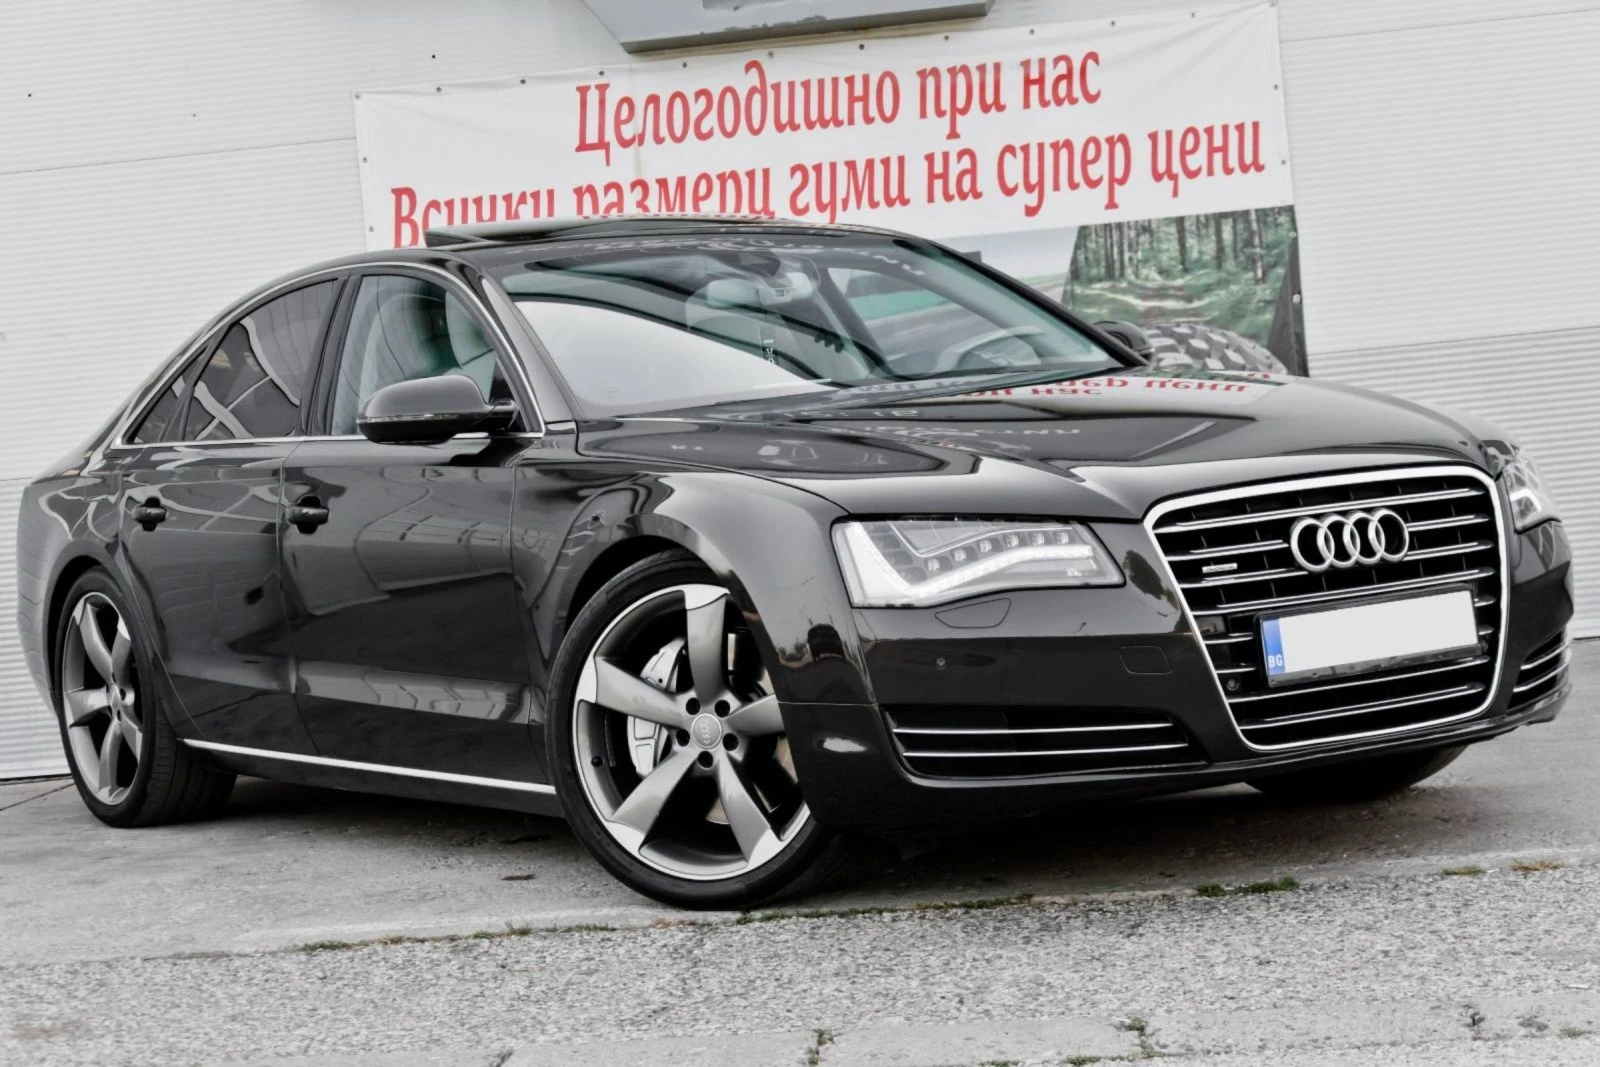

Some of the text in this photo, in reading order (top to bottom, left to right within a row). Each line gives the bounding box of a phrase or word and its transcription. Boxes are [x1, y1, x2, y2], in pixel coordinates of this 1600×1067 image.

[574, 50, 1102, 167] Целогодишно при нас
[787, 154, 912, 226] гуми
[923, 146, 984, 205] на
[995, 133, 1133, 219] супер
[1146, 120, 1266, 199] цени
[1267, 654, 1284, 669] BG
